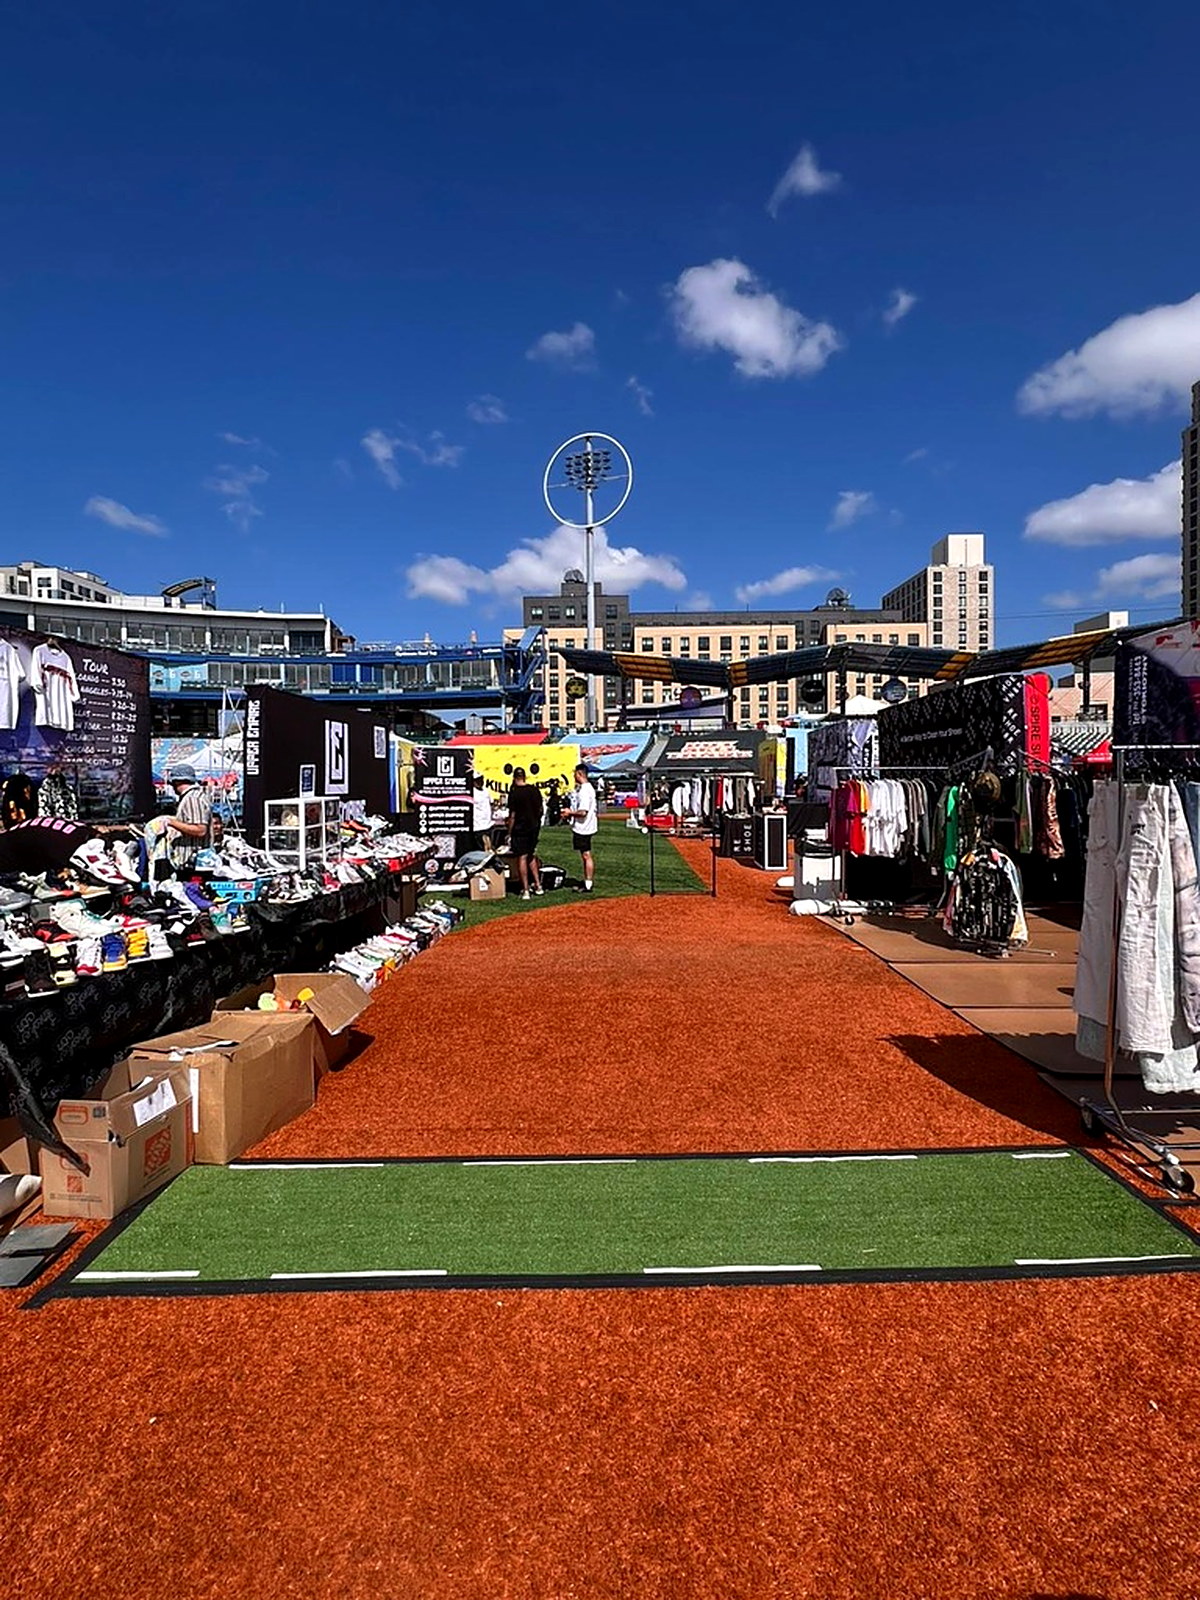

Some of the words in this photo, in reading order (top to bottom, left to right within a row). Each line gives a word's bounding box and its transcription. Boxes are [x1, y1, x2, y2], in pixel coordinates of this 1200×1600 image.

[82, 658, 109, 675] TOUR
[246, 699, 260, 738] EMPIRE
[246, 741, 260, 775] UPPER
